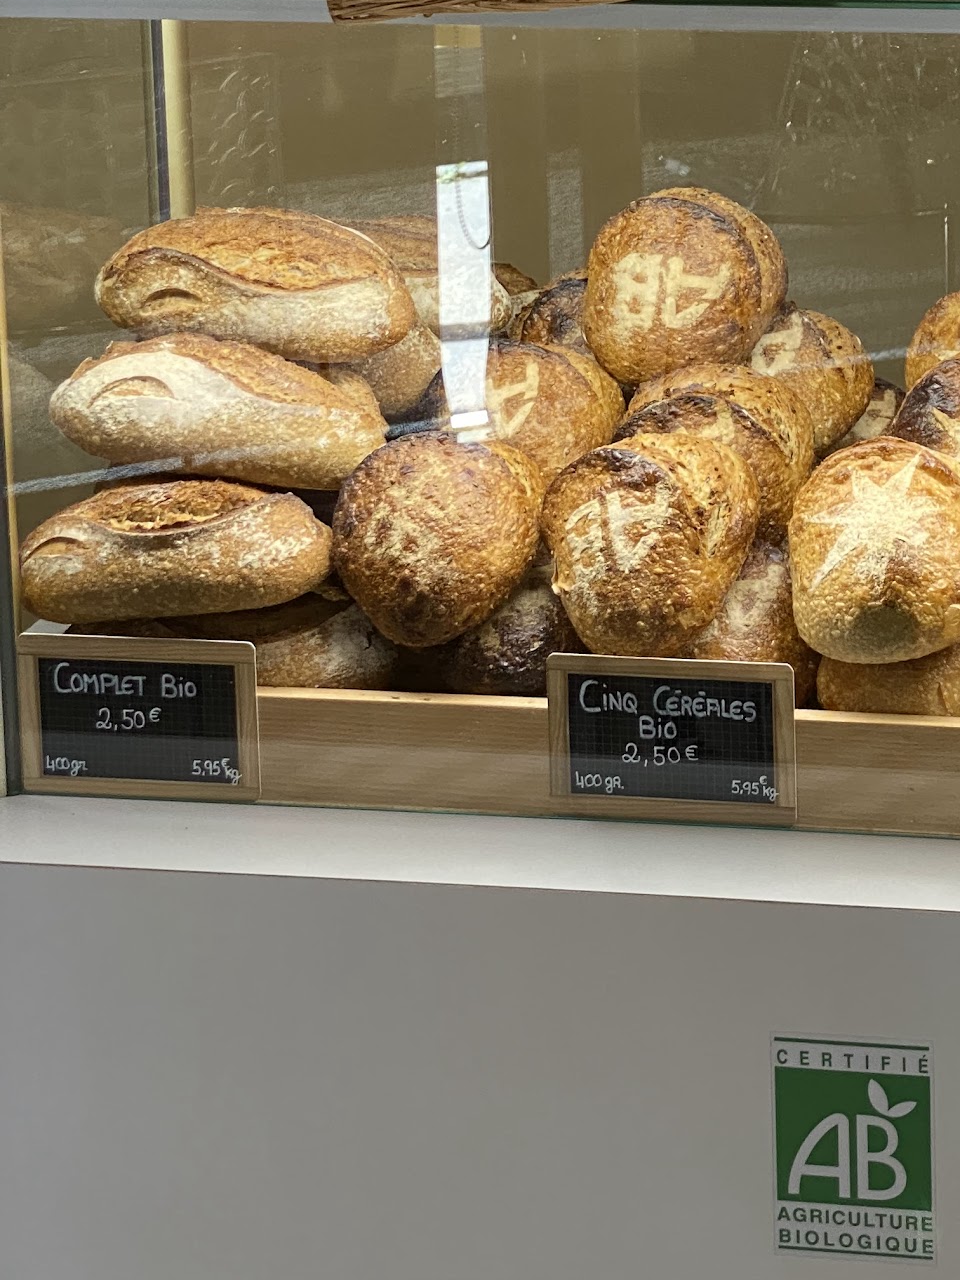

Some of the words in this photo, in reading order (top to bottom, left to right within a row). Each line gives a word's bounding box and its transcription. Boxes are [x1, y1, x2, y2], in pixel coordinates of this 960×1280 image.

[54, 662, 147, 696] COMPLET
[776, 1048, 930, 1074] CERTIFIÉ
[787, 1112, 908, 1202] AB
[777, 1206, 934, 1232] AGRICULTURE
[778, 1228, 934, 1255] BIOLOGIQUE
